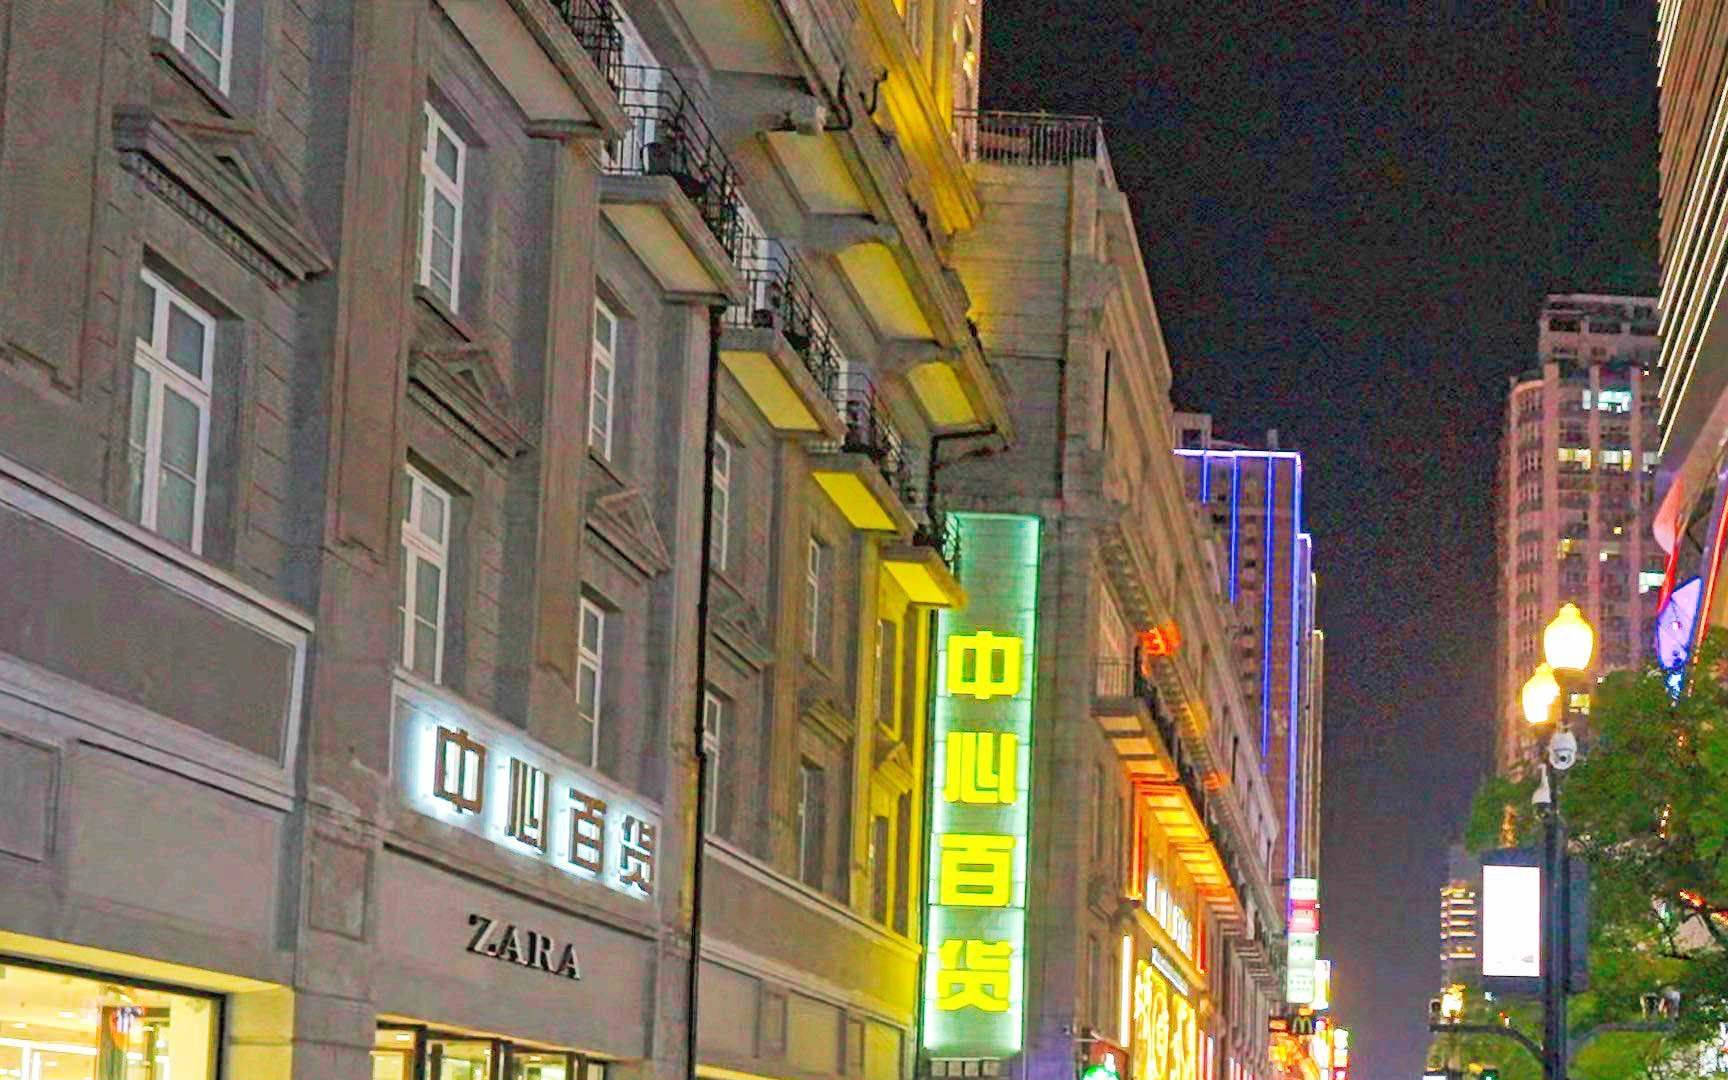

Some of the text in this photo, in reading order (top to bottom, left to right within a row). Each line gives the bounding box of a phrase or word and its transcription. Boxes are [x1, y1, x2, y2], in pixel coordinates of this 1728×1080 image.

[433, 725, 656, 895] 中心百货
[936, 631, 1022, 1012] 中心百货
[466, 913, 581, 980] ZARA
